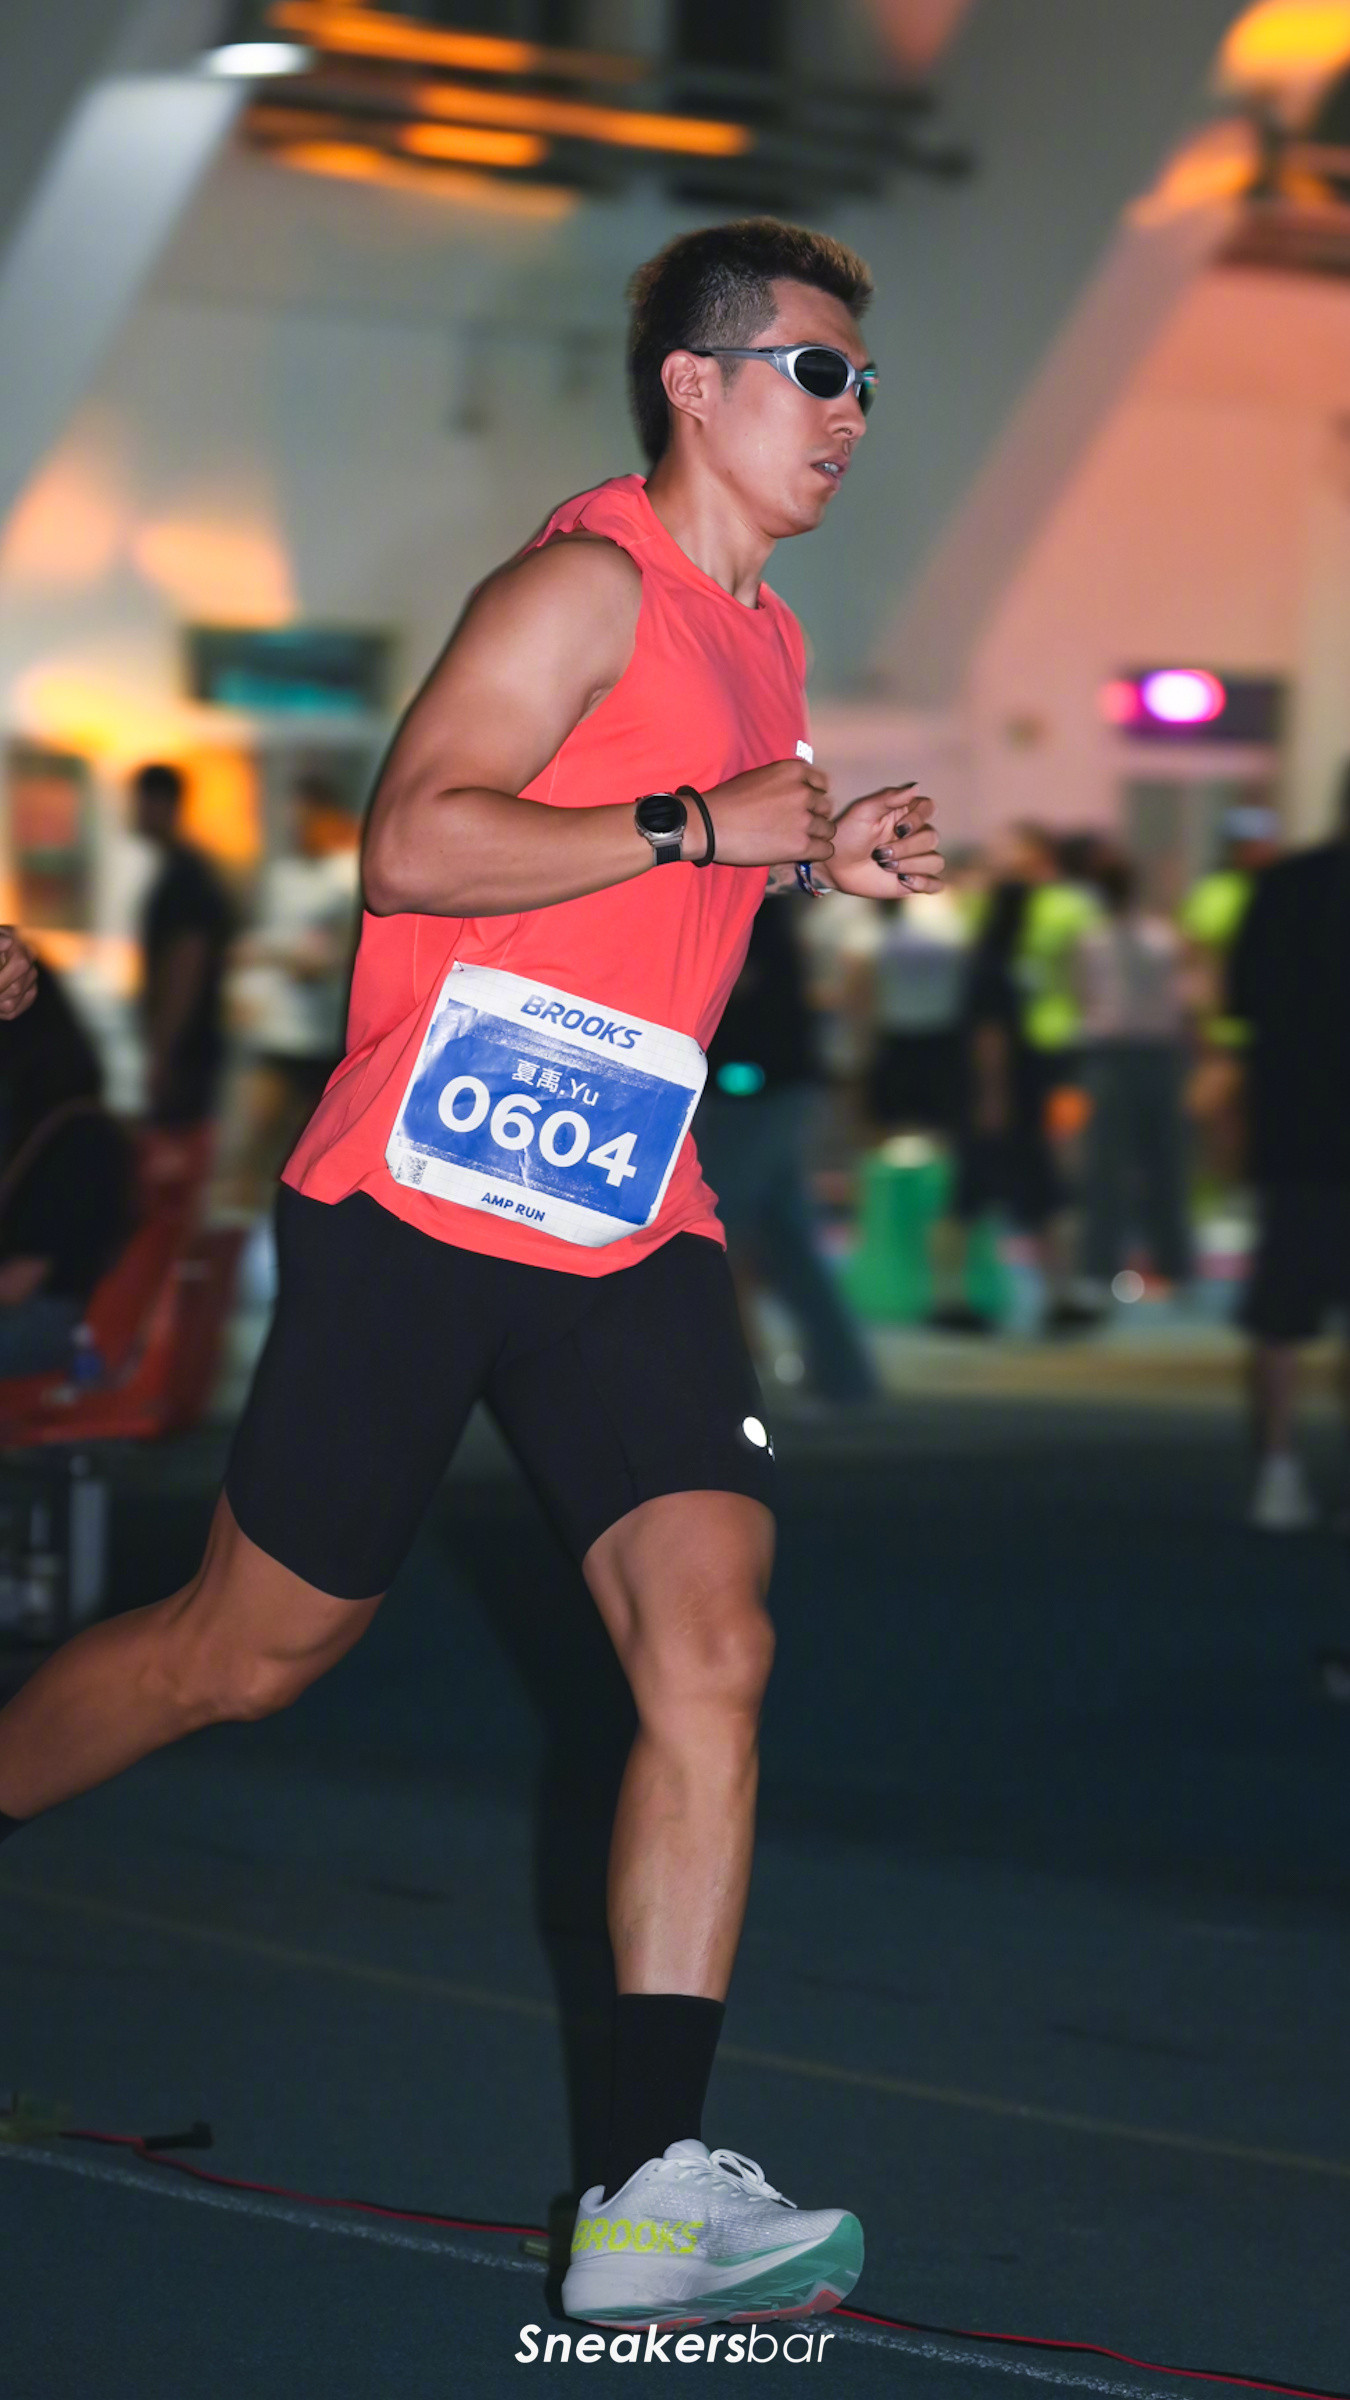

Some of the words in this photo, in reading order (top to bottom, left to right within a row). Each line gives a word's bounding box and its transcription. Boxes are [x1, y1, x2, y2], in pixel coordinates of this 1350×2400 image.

[520, 993, 643, 1050] BROOKS
[438, 1075, 638, 1188] 0604
[481, 1192, 514, 1209] AMP
[514, 1203, 546, 1223] RUN
[571, 2217, 705, 2254] BROOKS
